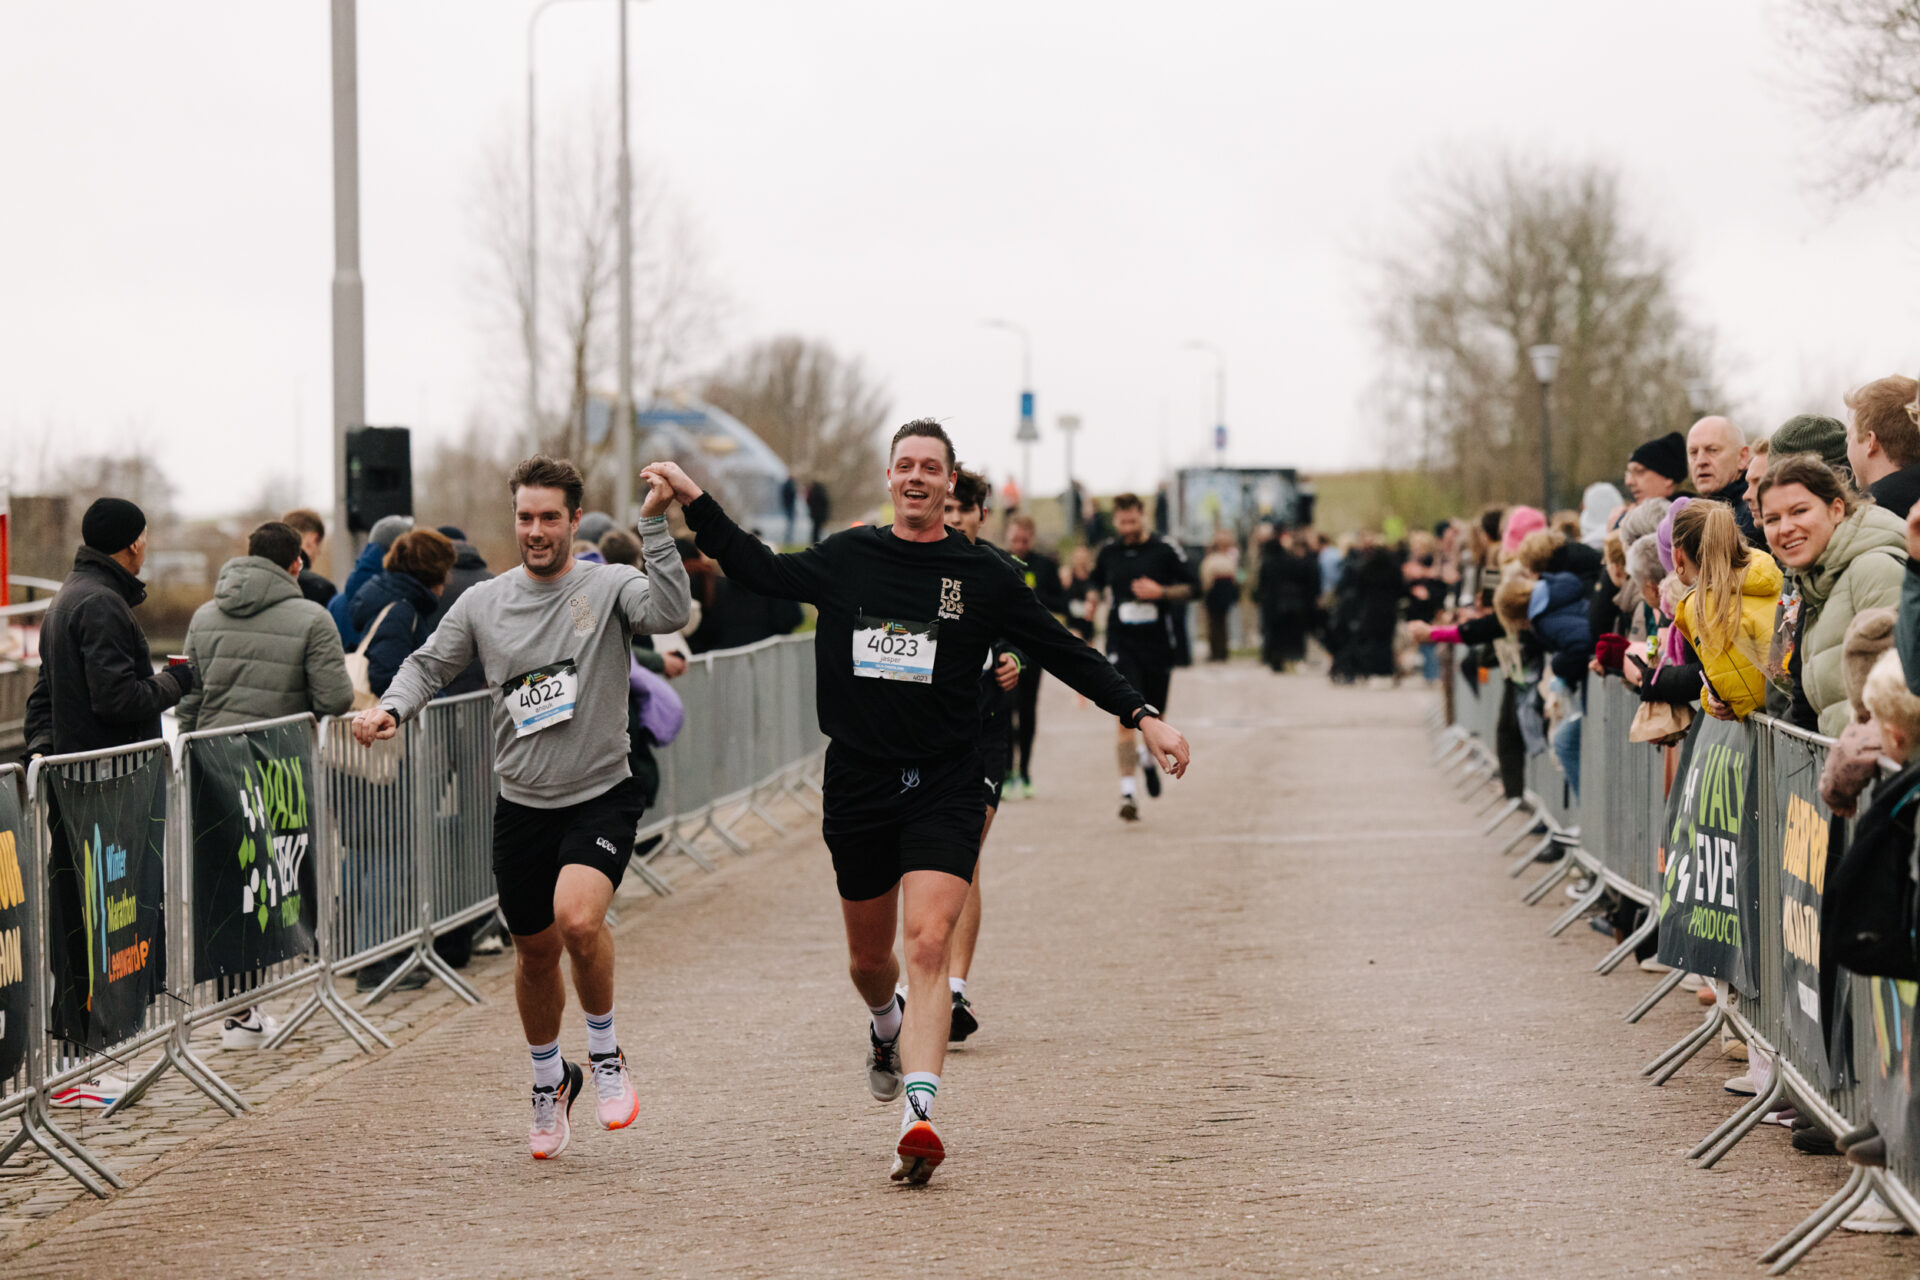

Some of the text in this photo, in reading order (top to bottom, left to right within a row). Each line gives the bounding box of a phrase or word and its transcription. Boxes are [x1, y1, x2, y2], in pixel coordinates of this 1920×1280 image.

[867, 635, 919, 657] 4023
[520, 680, 565, 708] 4022
[106, 843, 126, 883] Winter
[107, 888, 136, 933] Marathon
[108, 932, 151, 983] Leeuwarde
